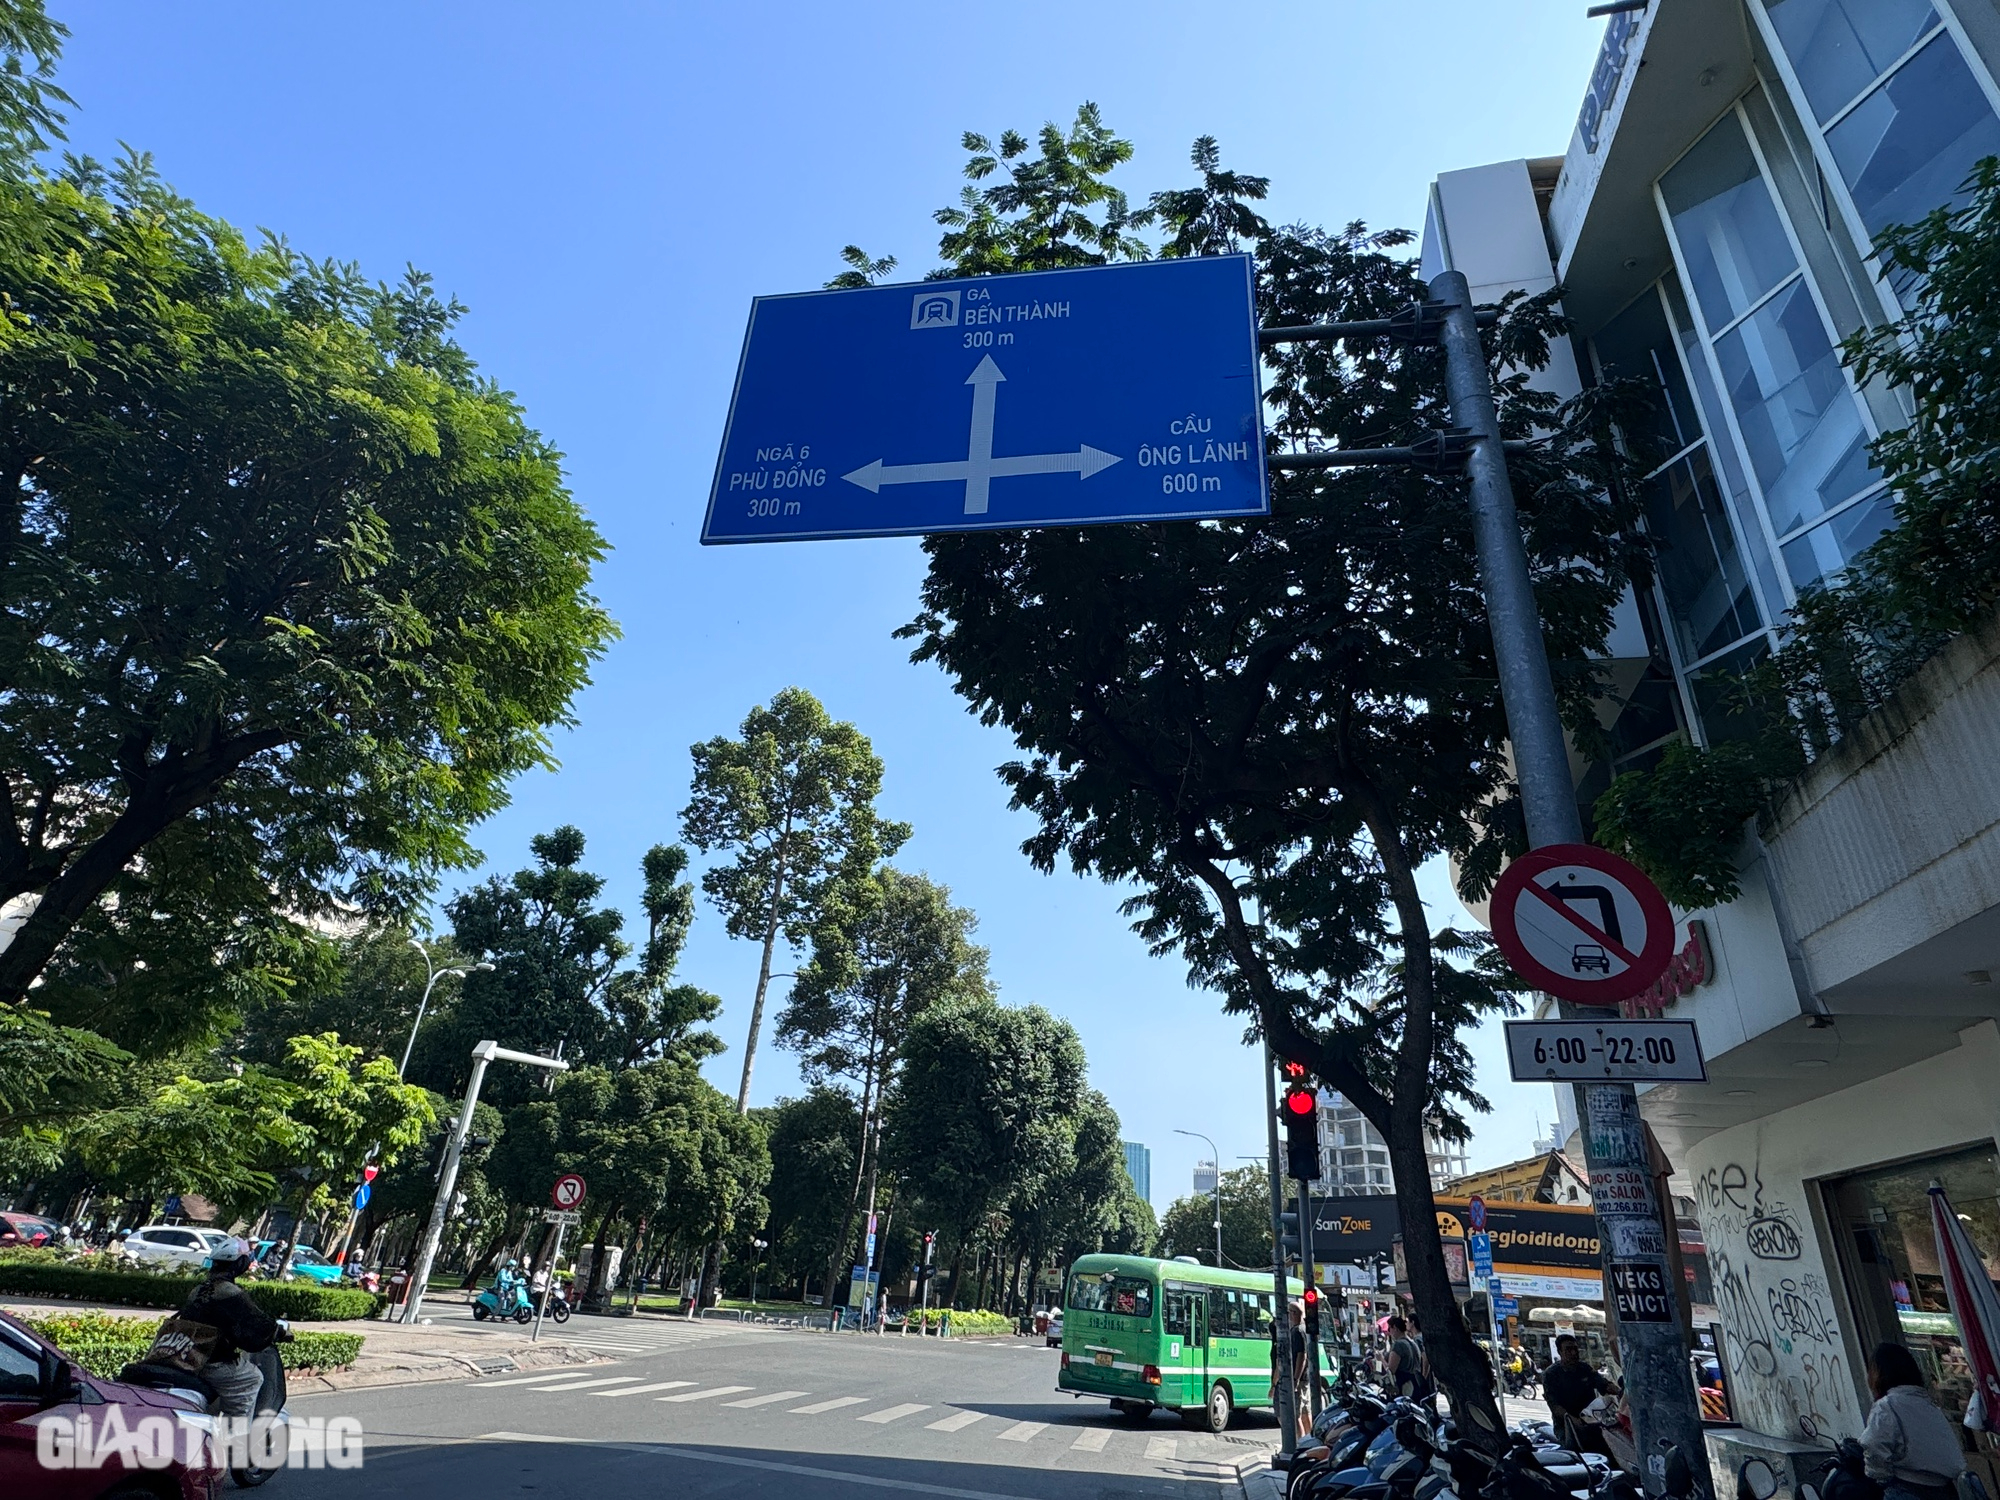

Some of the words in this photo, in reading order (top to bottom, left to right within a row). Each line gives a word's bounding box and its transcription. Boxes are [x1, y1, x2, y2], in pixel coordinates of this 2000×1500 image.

[966, 287, 991, 301] GA
[964, 302, 1002, 326] BẾN
[1005, 299, 1070, 322] THÀNH
[962, 330, 993, 348] 300
[997, 332, 1014, 346] m
[1170, 412, 1211, 435] CẦU
[756, 442, 794, 462] NGÃ
[799, 445, 811, 460] 6
[1138, 443, 1182, 467] ÔNG
[1188, 438, 1248, 464] LÃNH
[729, 466, 769, 491] PHÙ
[772, 461, 827, 489] ĐỔNG
[1162, 473, 1199, 494] 600
[1202, 476, 1221, 492] m
[747, 497, 780, 517] 300
[783, 501, 801, 516] m
[1609, 1185, 1646, 1200] SALON
[1466, 1227, 1601, 1255] tegioididong
[1614, 1271, 1661, 1290] VEKS
[1617, 1294, 1666, 1313] EVICT
